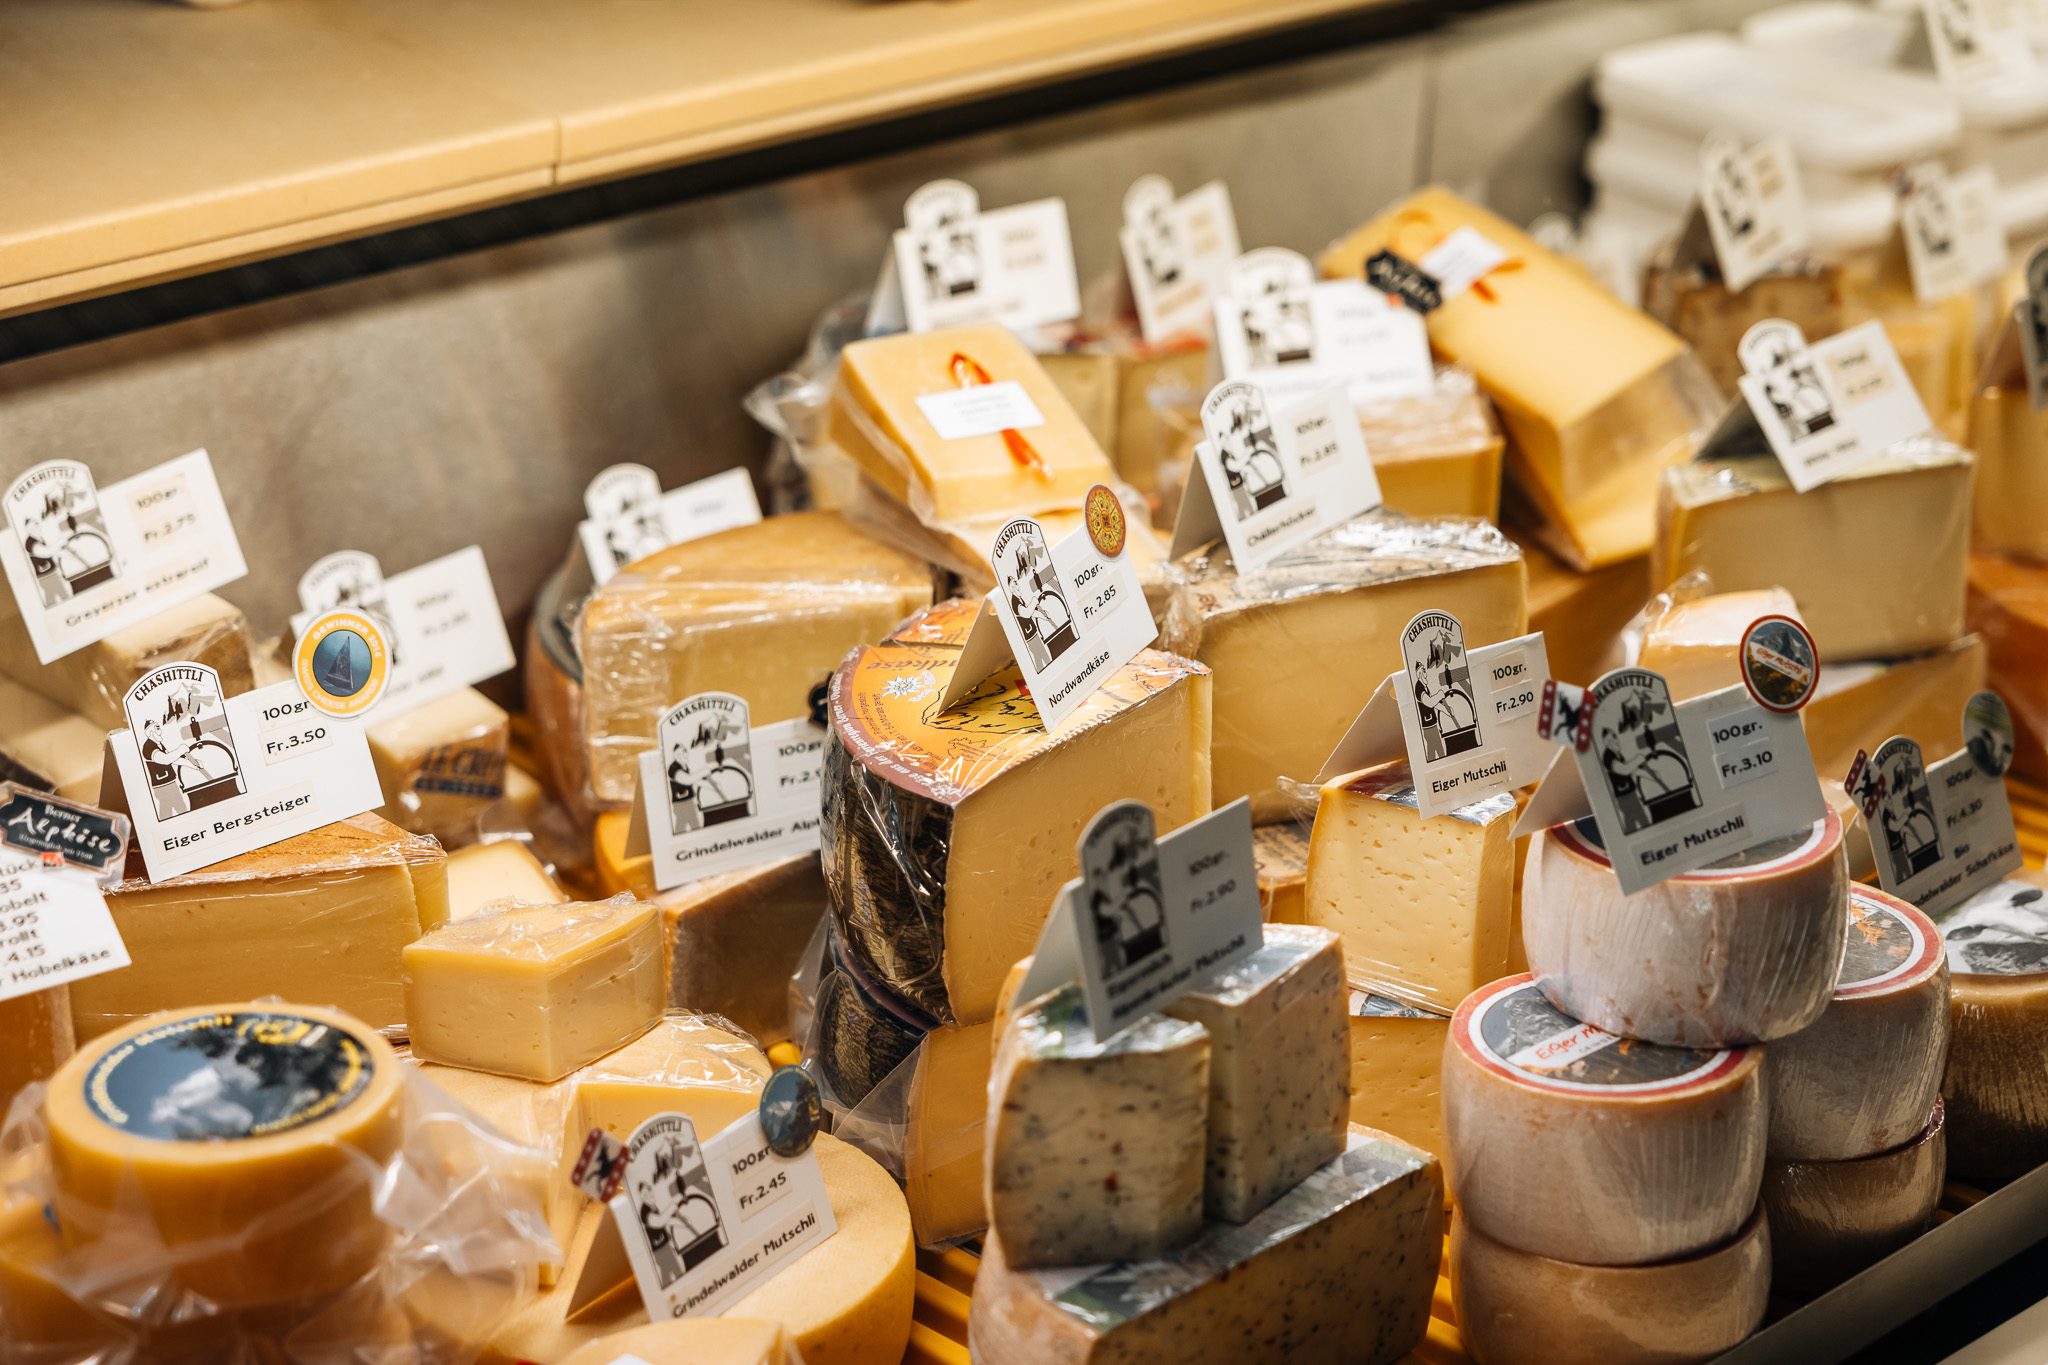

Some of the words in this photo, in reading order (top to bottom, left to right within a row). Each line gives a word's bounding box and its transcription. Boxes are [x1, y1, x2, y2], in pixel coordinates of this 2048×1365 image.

[14, 466, 76, 502] CHASHITTLI
[995, 521, 1033, 559] CHASHITTLI
[1074, 564, 1104, 588] 100gr.
[313, 619, 369, 640] GEWINNER
[1408, 616, 1453, 643] CHASHITTLI
[134, 668, 203, 701] CHASHITTLI
[1048, 648, 1110, 708] Nordwandkäse
[1493, 662, 1527, 681] 100gr.
[1496, 692, 1535, 714] Fr.2.90
[1596, 675, 1653, 702] HASHITTLI
[669, 699, 736, 726] CHASHITTLI
[266, 727, 326, 754] Fr.3.50
[1713, 721, 1763, 744] 100gr.
[1432, 777, 1460, 794] Eiger
[1463, 760, 1507, 783] Mutschli
[1722, 750, 1773, 778] Fr.3.10
[44, 803, 82, 823] Berner
[164, 829, 207, 852] Eiger
[213, 791, 311, 835] Bergsteiger
[676, 826, 784, 862] Grindelwalder
[1640, 840, 1679, 866] Eiger
[1684, 815, 1745, 849] Mutschli
[12, 949, 110, 982] Hobelkäse
[739, 1171, 787, 1210] Fr.2.45
[673, 1252, 760, 1318] Grindelwalder
[763, 1213, 817, 1255] Mutschli
